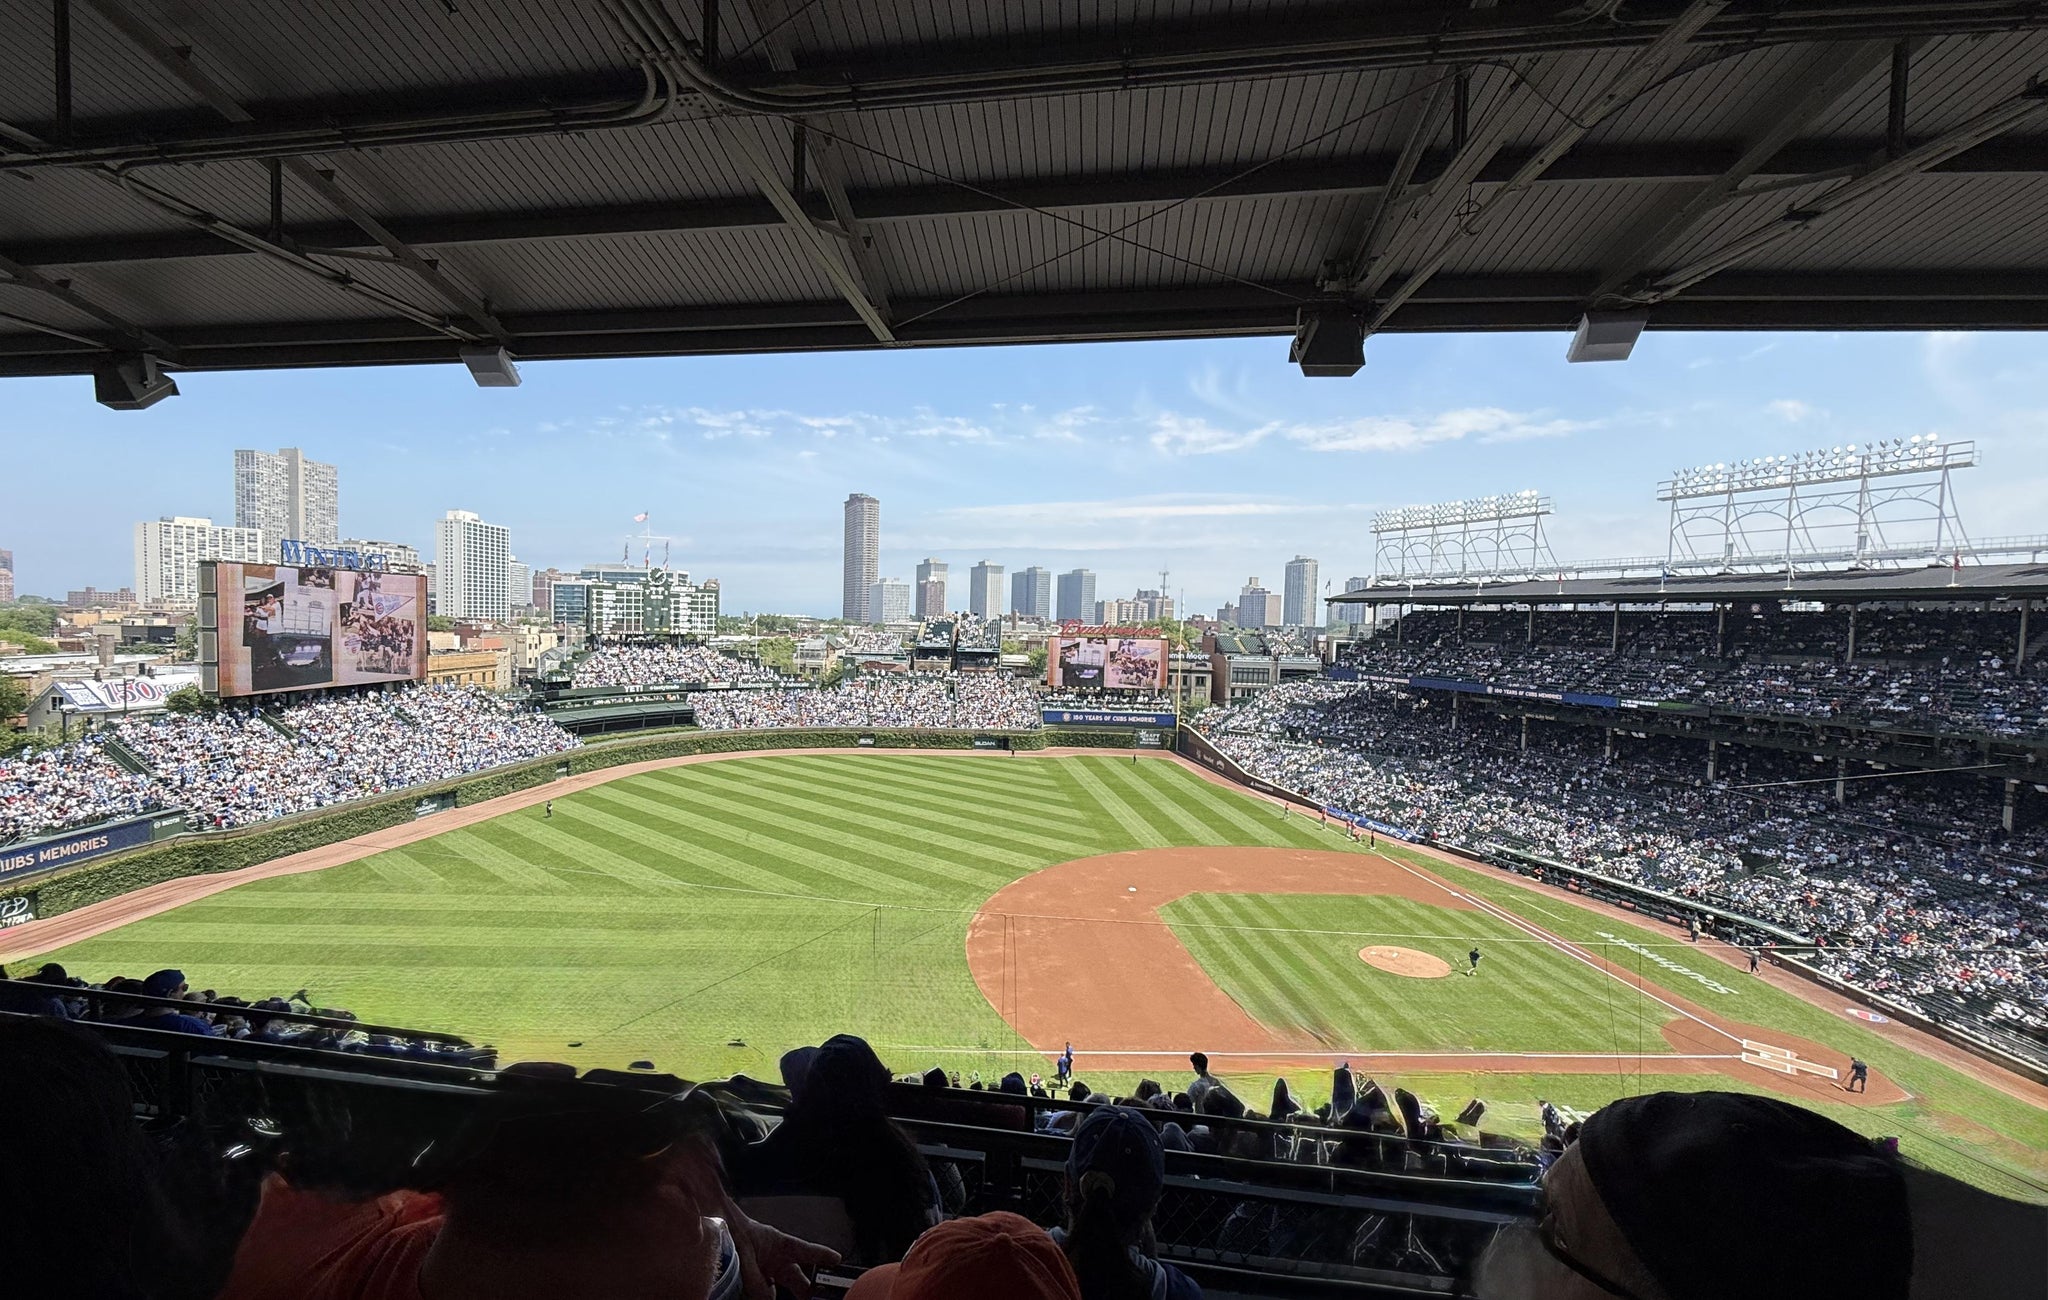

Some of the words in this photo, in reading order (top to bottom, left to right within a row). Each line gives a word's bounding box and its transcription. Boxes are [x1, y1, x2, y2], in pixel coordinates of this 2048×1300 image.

[281, 539, 388, 571] WINTRUST
[102, 679, 158, 705] 150
[39, 835, 109, 863] MEMORIES
